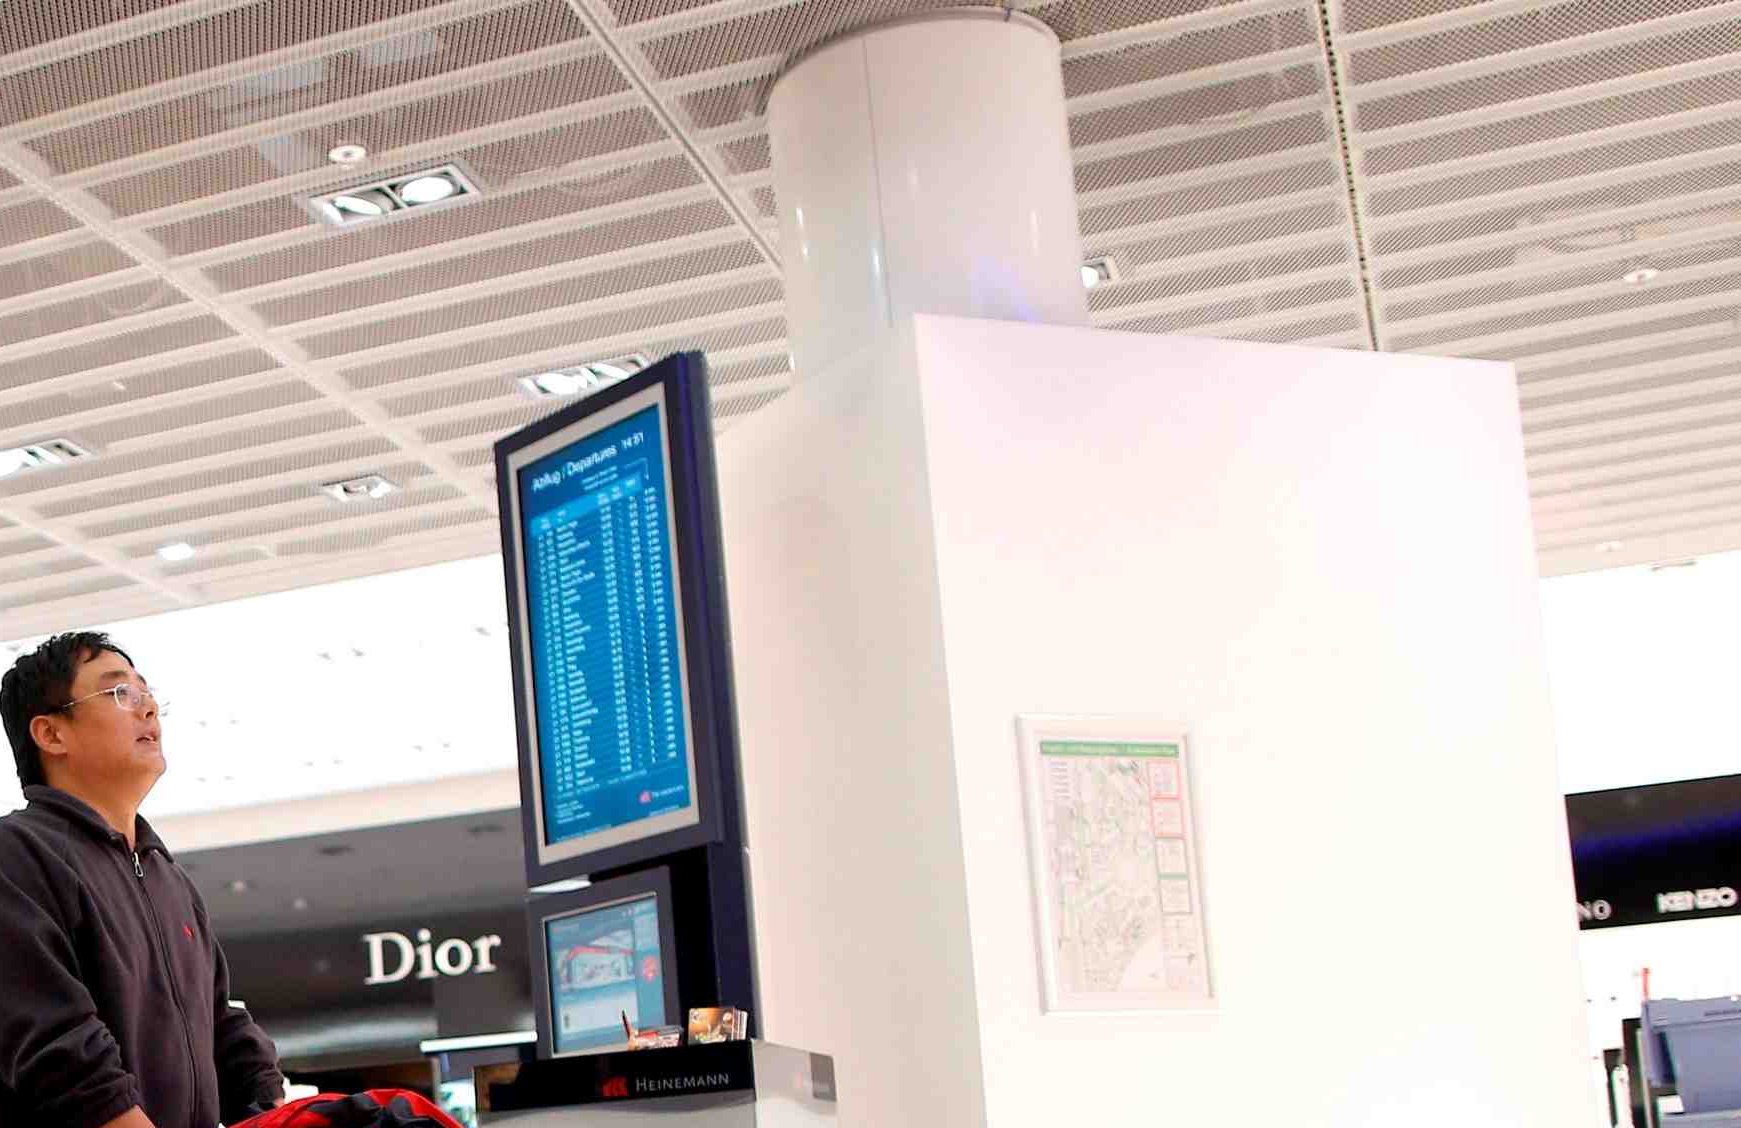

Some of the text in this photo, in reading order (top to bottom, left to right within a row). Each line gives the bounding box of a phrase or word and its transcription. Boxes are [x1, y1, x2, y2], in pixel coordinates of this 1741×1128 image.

[567, 445, 617, 475] Departures
[362, 928, 502, 985] Dior
[635, 1073, 730, 1092] HEINEMANN
